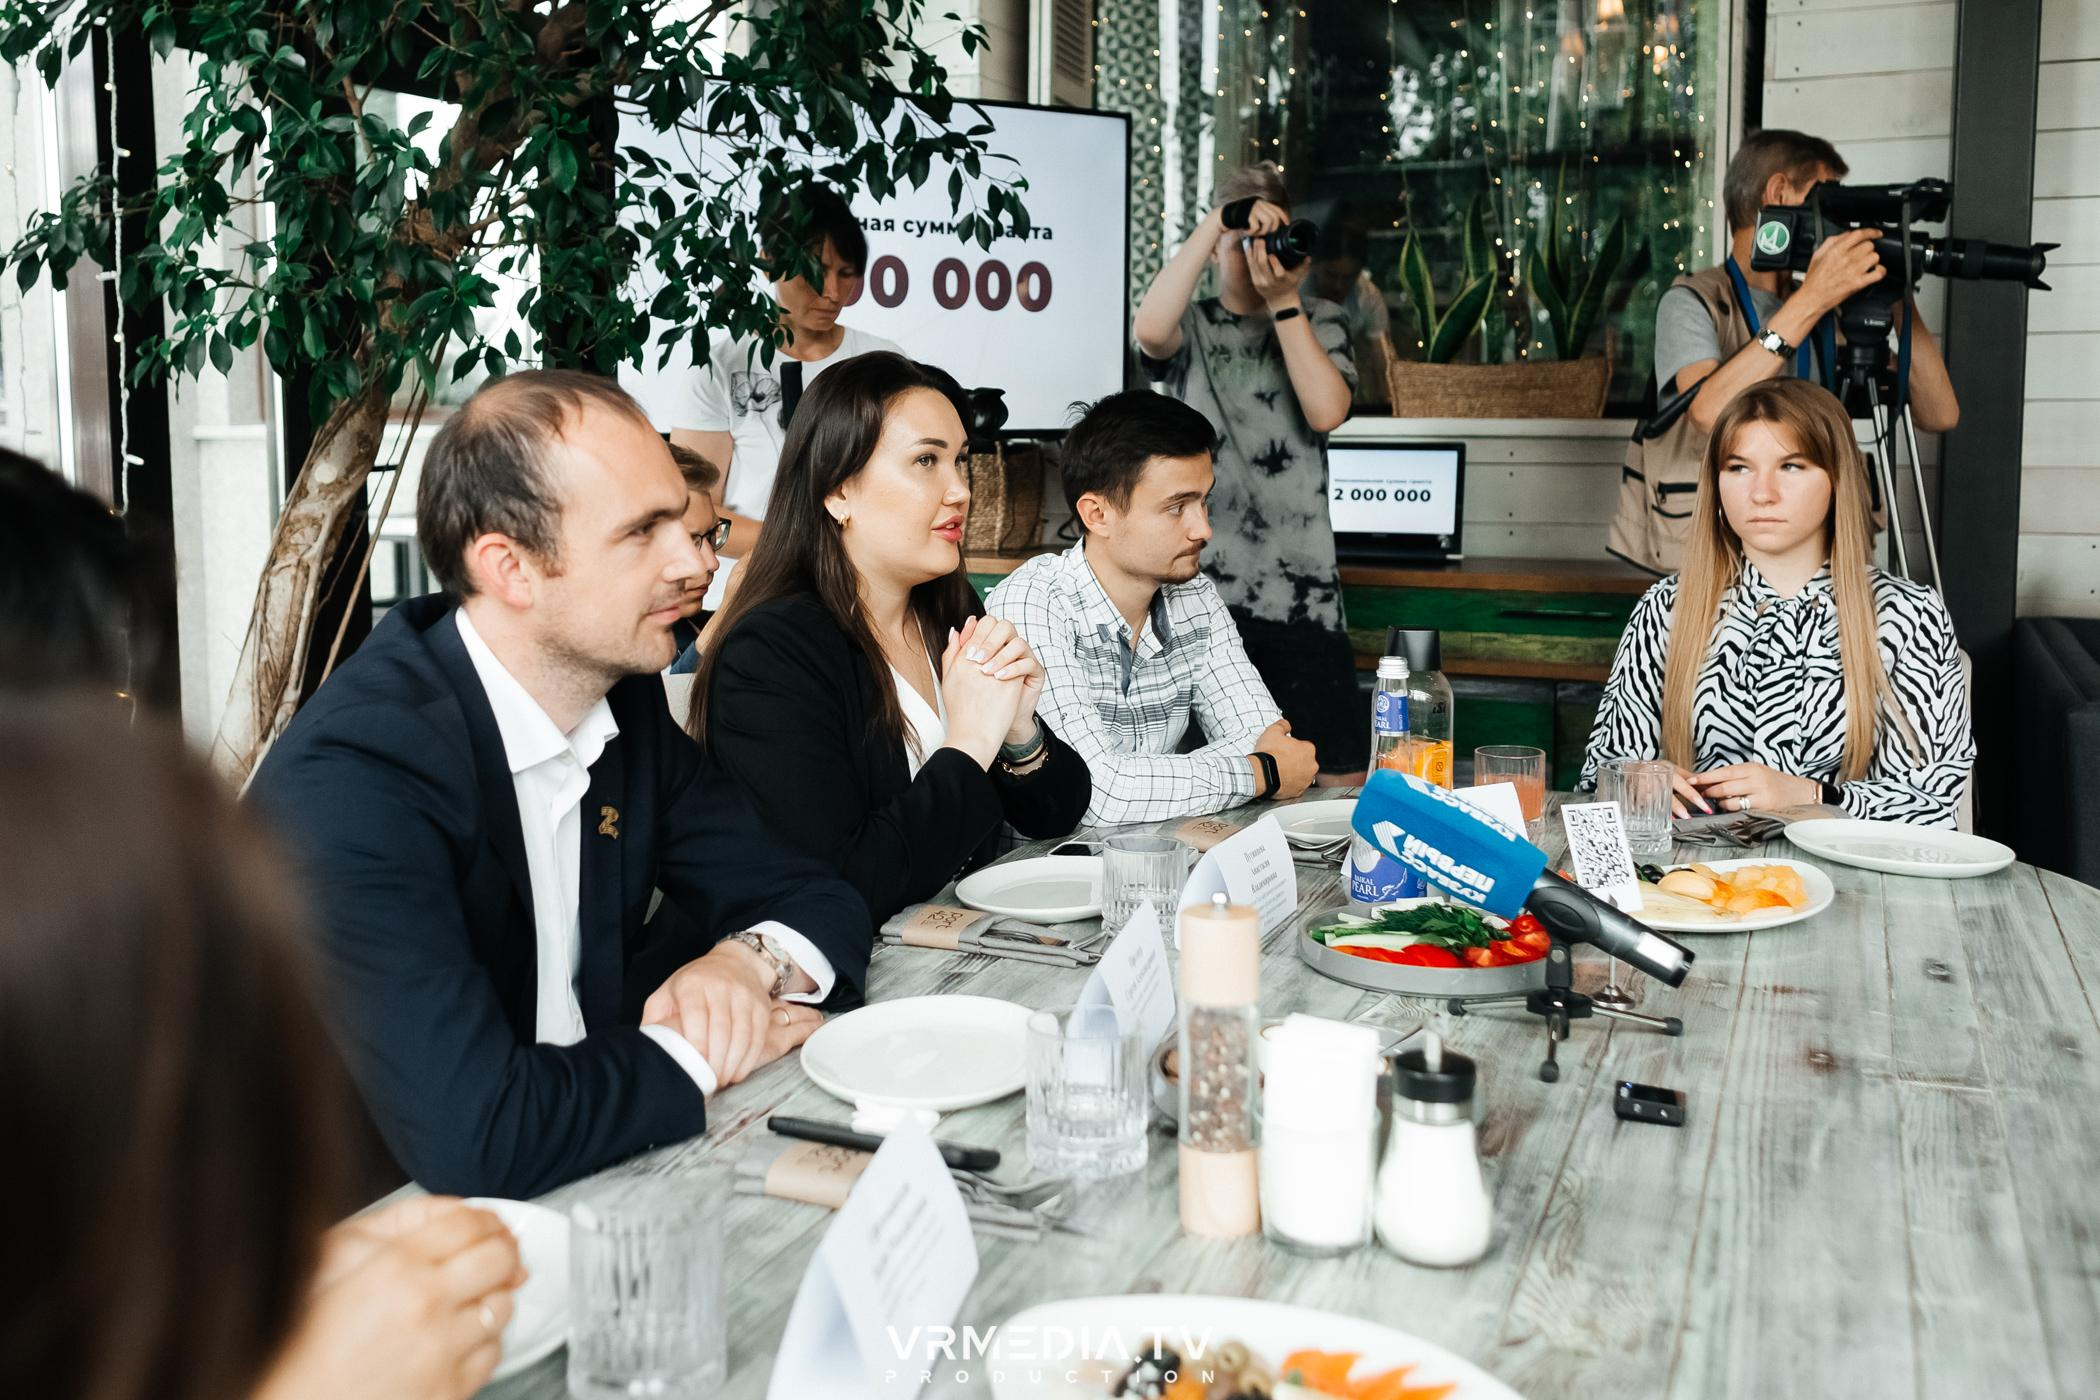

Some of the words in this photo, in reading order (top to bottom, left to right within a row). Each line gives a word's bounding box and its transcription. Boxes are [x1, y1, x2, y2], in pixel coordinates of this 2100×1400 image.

[903, 220, 960, 237] сумм
[932, 257, 1053, 312] 000
[1334, 488, 1344, 500] 2
[1350, 488, 1387, 501] 000
[1394, 489, 1432, 502] 000
[1400, 850, 1487, 904] КУЗБАСС
[1402, 833, 1496, 893] ПЕРВЫЙ
[1352, 880, 1379, 897] PEARL
